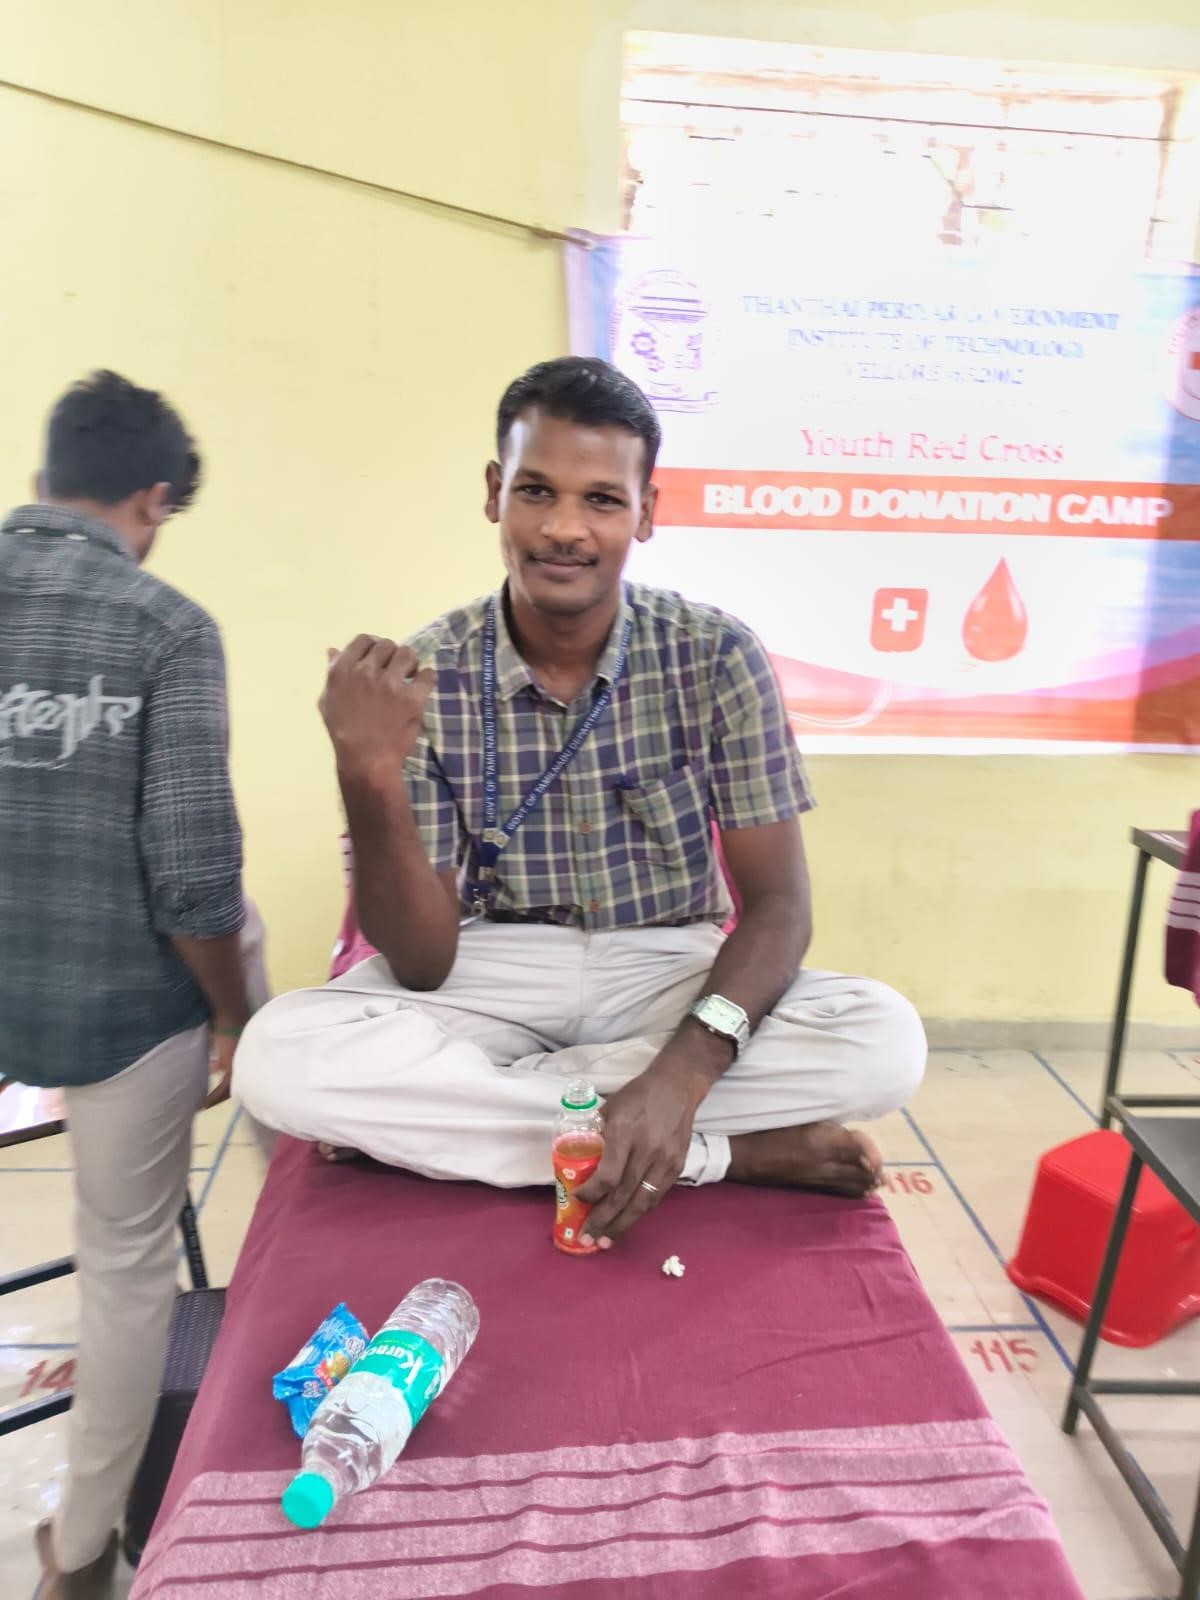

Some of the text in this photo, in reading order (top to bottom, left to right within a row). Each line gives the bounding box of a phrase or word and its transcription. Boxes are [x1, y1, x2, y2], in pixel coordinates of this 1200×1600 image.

[800, 429, 1065, 464] Youth Red Cross
[703, 483, 1173, 527] BLOOD DONATION CAMP
[971, 1339, 1037, 1374] 115
